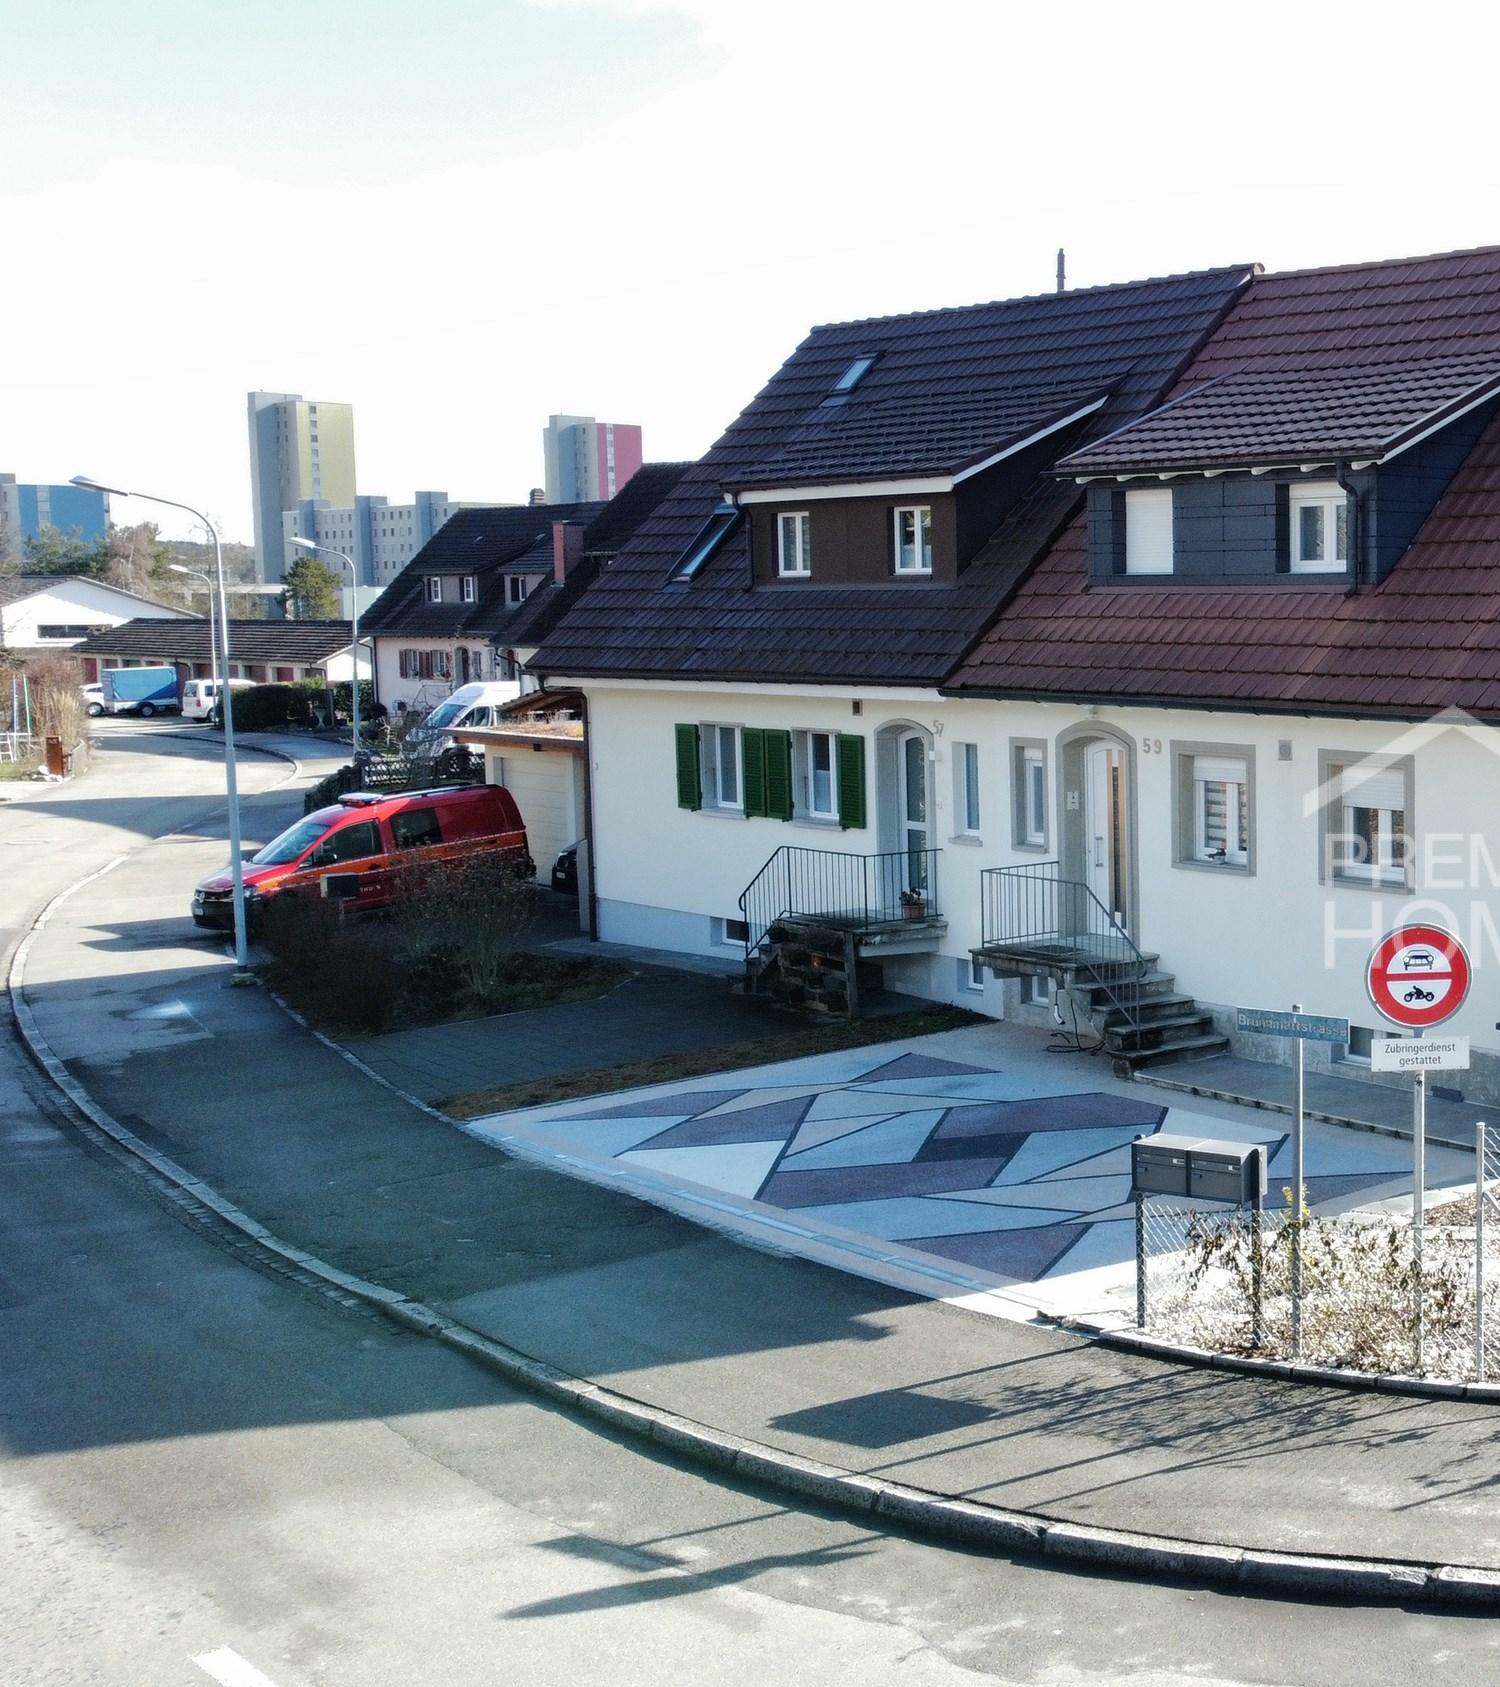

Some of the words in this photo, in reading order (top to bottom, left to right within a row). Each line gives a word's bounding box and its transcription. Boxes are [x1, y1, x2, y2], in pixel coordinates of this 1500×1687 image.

[932, 719, 945, 738] 57
[1142, 737, 1162, 755] 59
[1384, 1042, 1456, 1056] Zubringerdienst
[1399, 1055, 1441, 1068] gestattet
